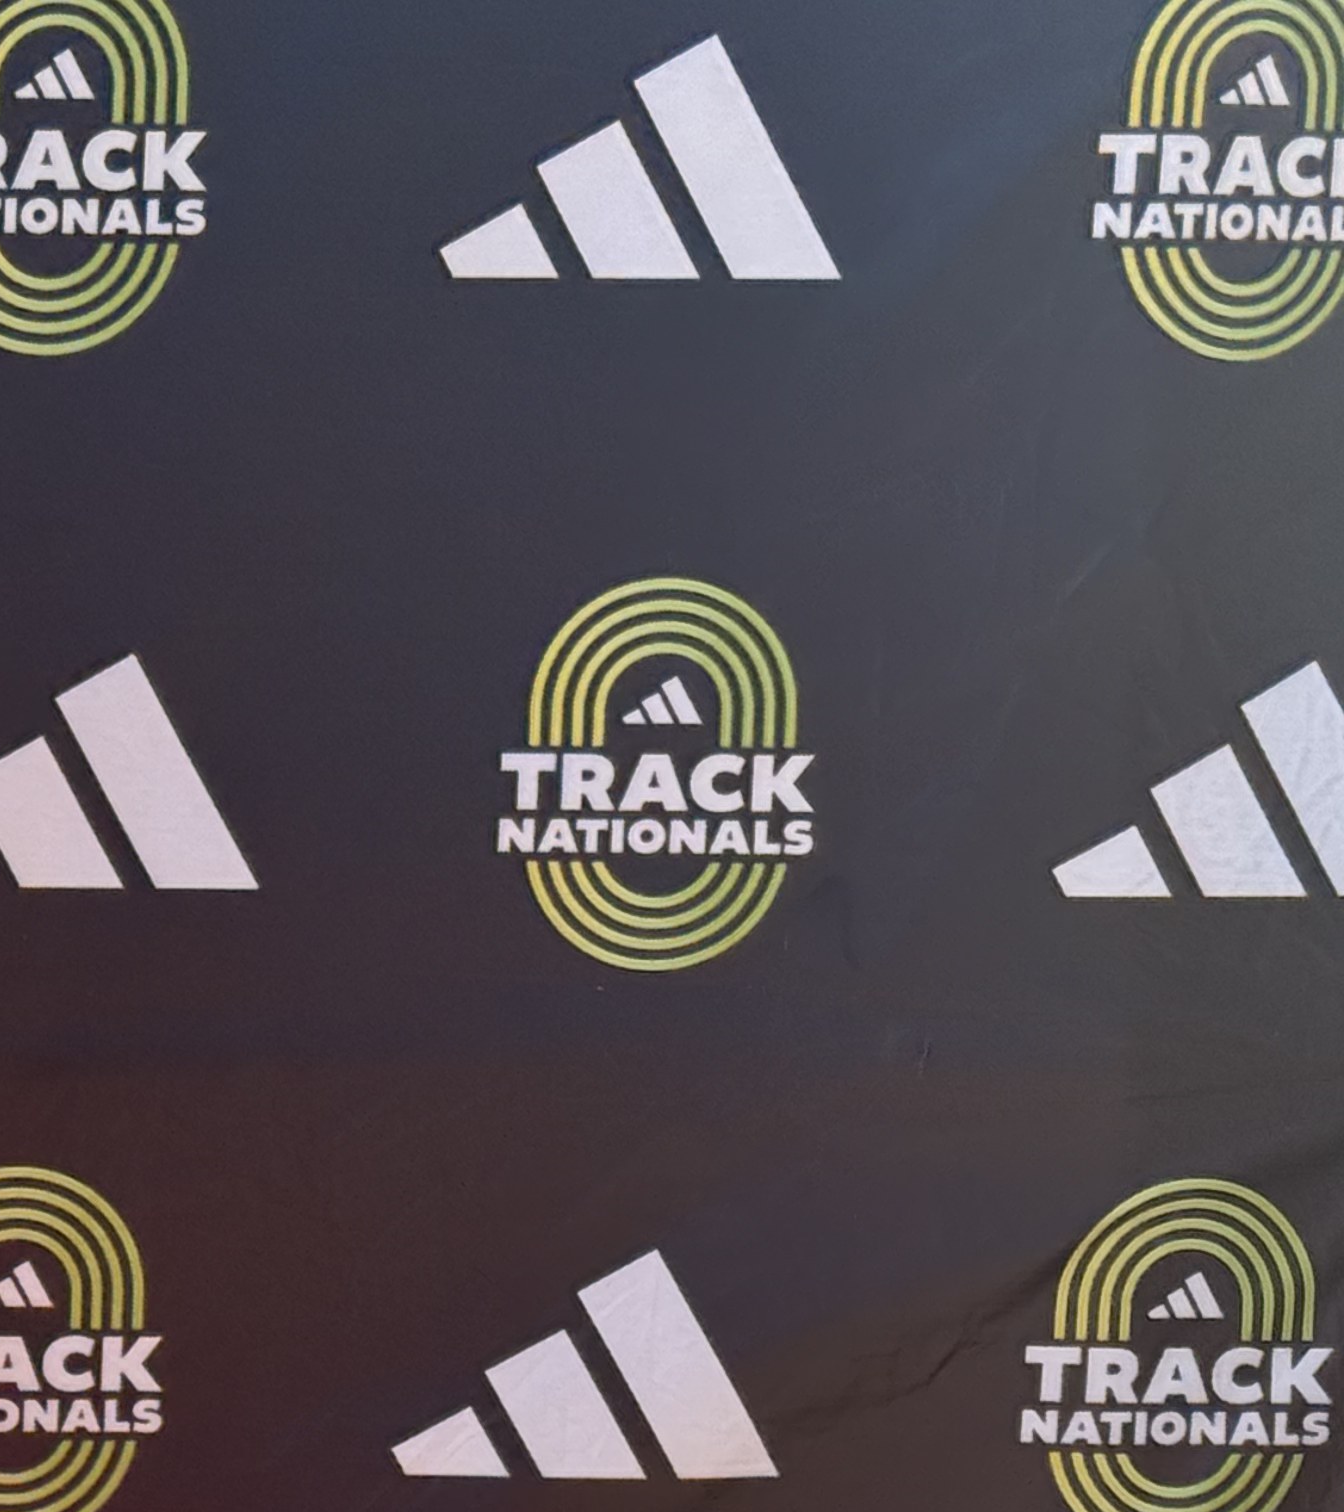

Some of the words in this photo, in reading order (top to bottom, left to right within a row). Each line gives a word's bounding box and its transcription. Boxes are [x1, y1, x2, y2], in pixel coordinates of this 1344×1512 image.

[1098, 133, 1344, 198] TRAC
[501, 753, 815, 812] TRACK
[498, 818, 813, 855] NATIONALS
[1025, 1346, 1334, 1404] TRACK
[1020, 1409, 1329, 1445] NATIONALS
